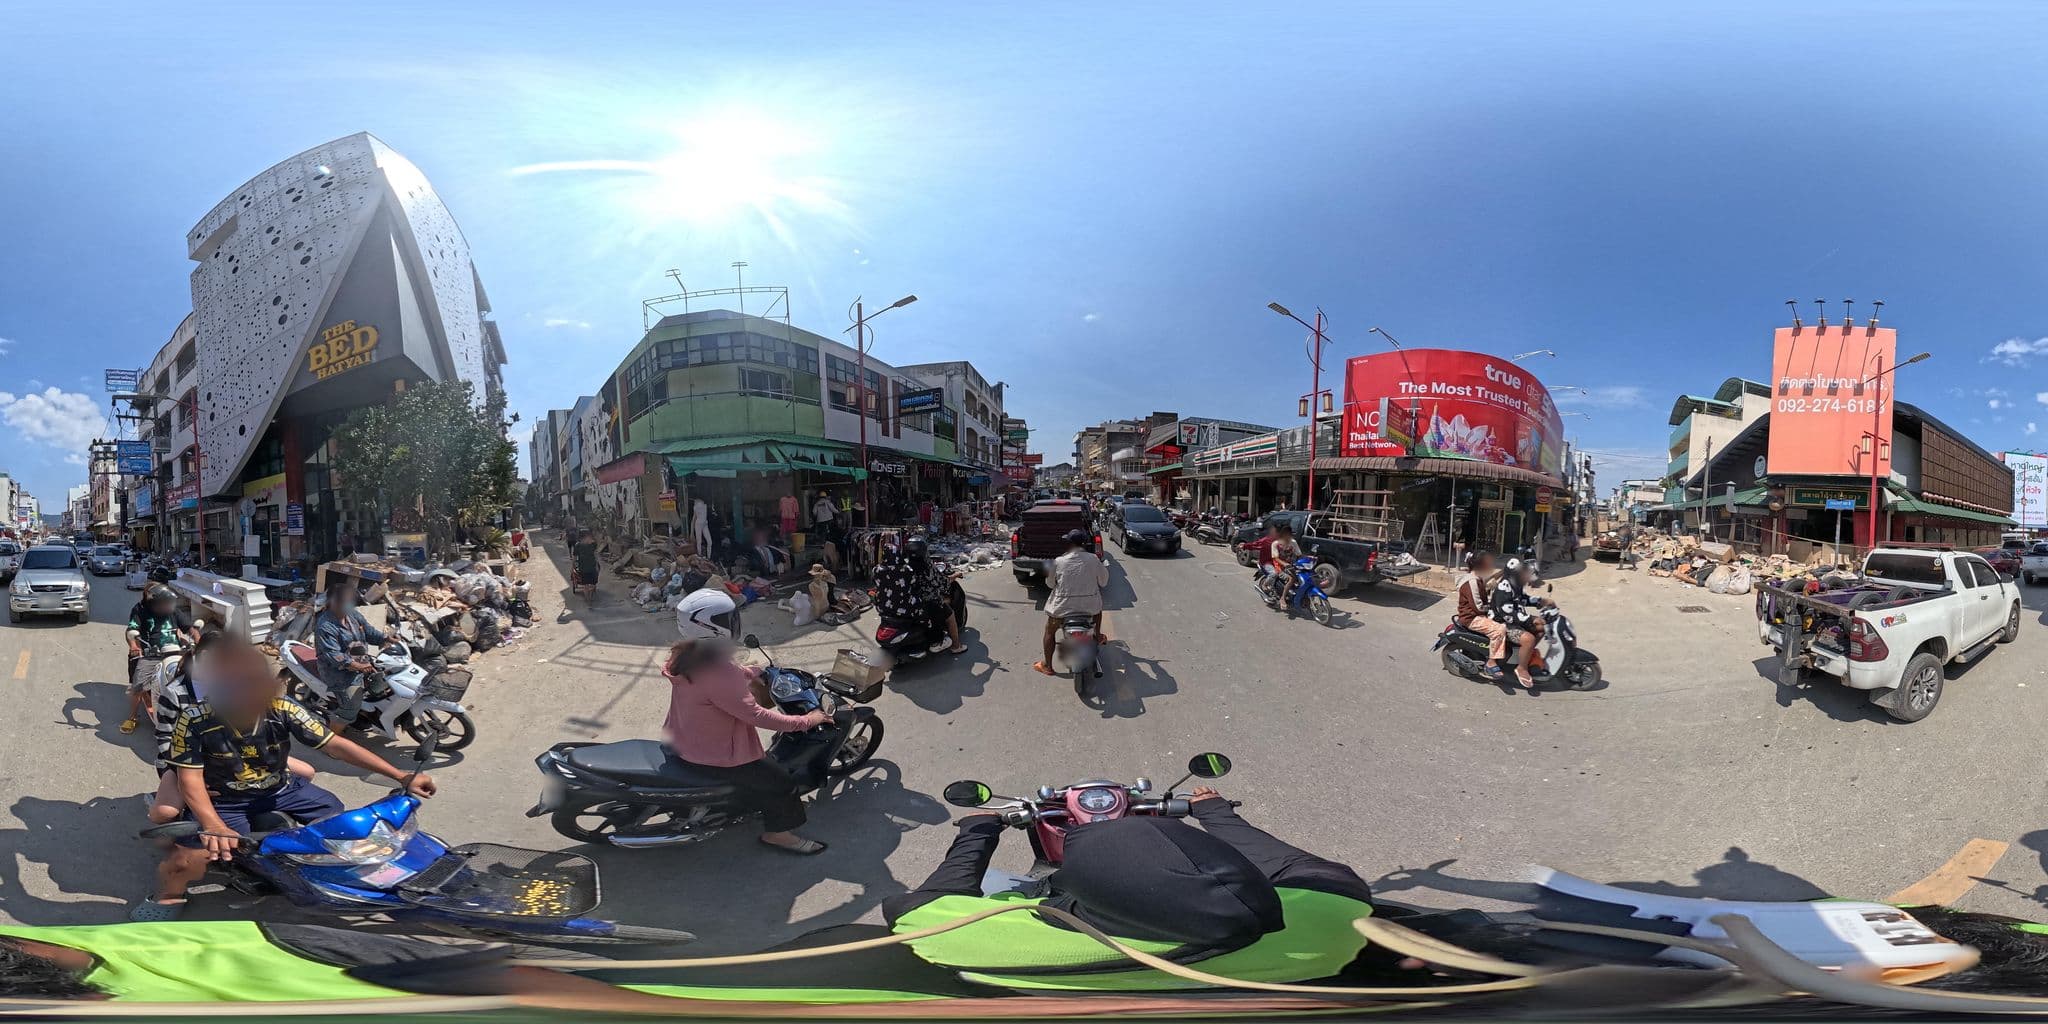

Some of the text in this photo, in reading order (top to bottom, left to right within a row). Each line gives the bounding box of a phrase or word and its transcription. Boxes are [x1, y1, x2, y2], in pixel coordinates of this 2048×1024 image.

[322, 320, 356, 340] THE
[308, 326, 378, 372] BED
[316, 350, 371, 380] HATYAI
[1485, 363, 1521, 389] true
[1399, 382, 1428, 394] The
[1432, 382, 1472, 397] Most
[1475, 386, 1521, 410] Trusted
